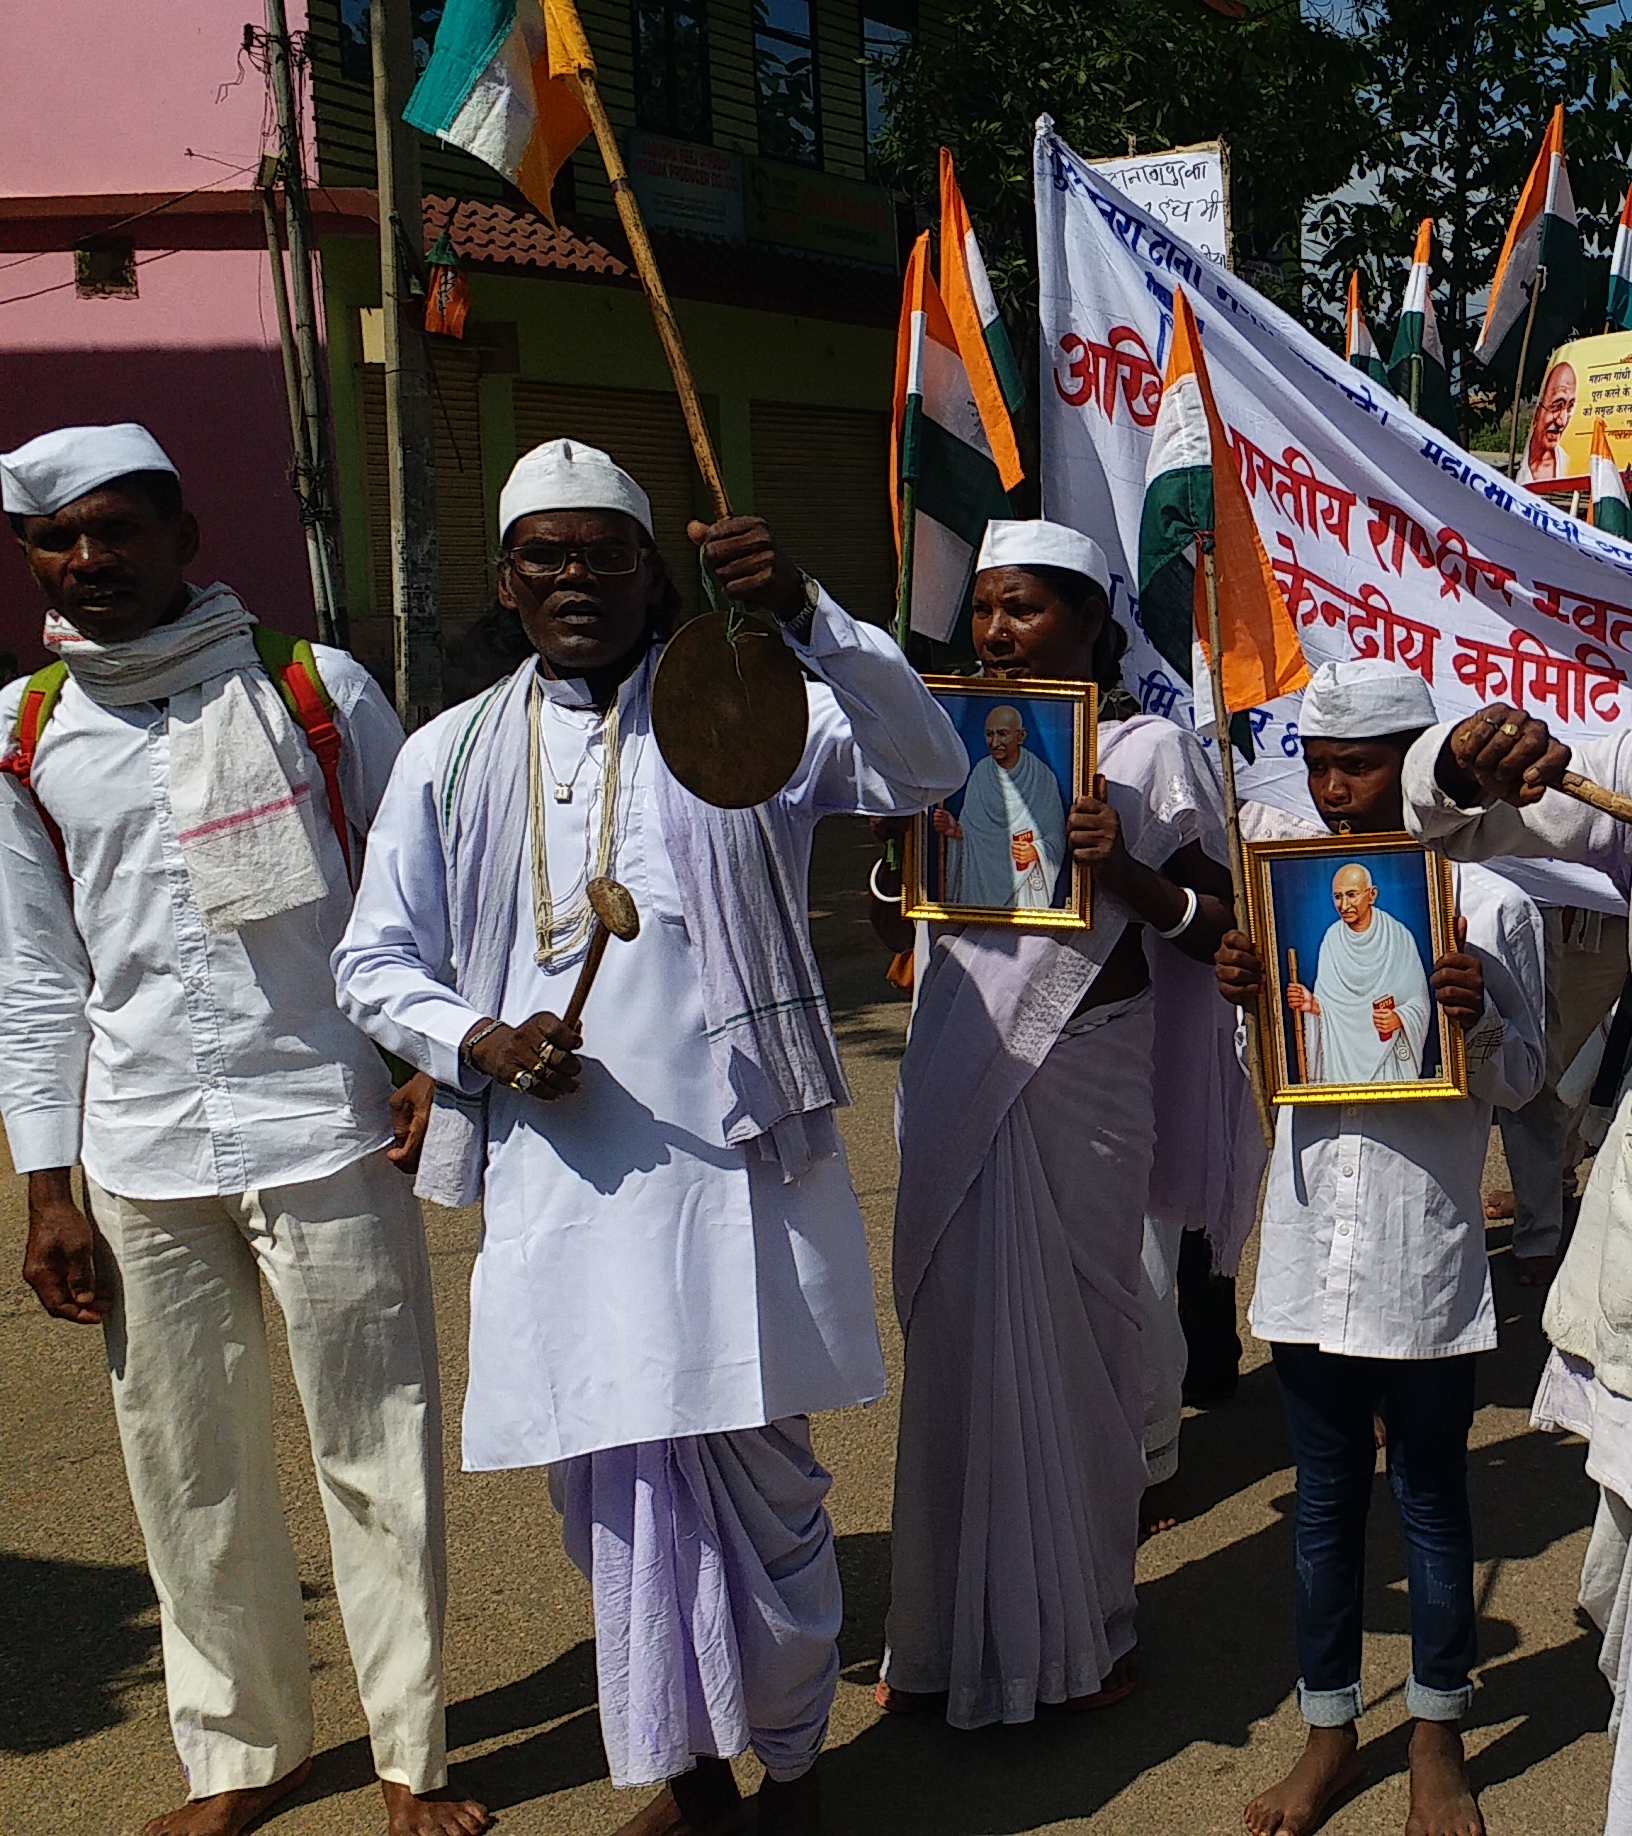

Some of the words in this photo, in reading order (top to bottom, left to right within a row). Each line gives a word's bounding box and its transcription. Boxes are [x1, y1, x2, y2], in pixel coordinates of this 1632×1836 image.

[1053, 325, 1165, 427] अखि
[1623, 384, 1631, 396] के
[1583, 404, 1593, 417] को
[1420, 435, 1514, 512] महात्मा
